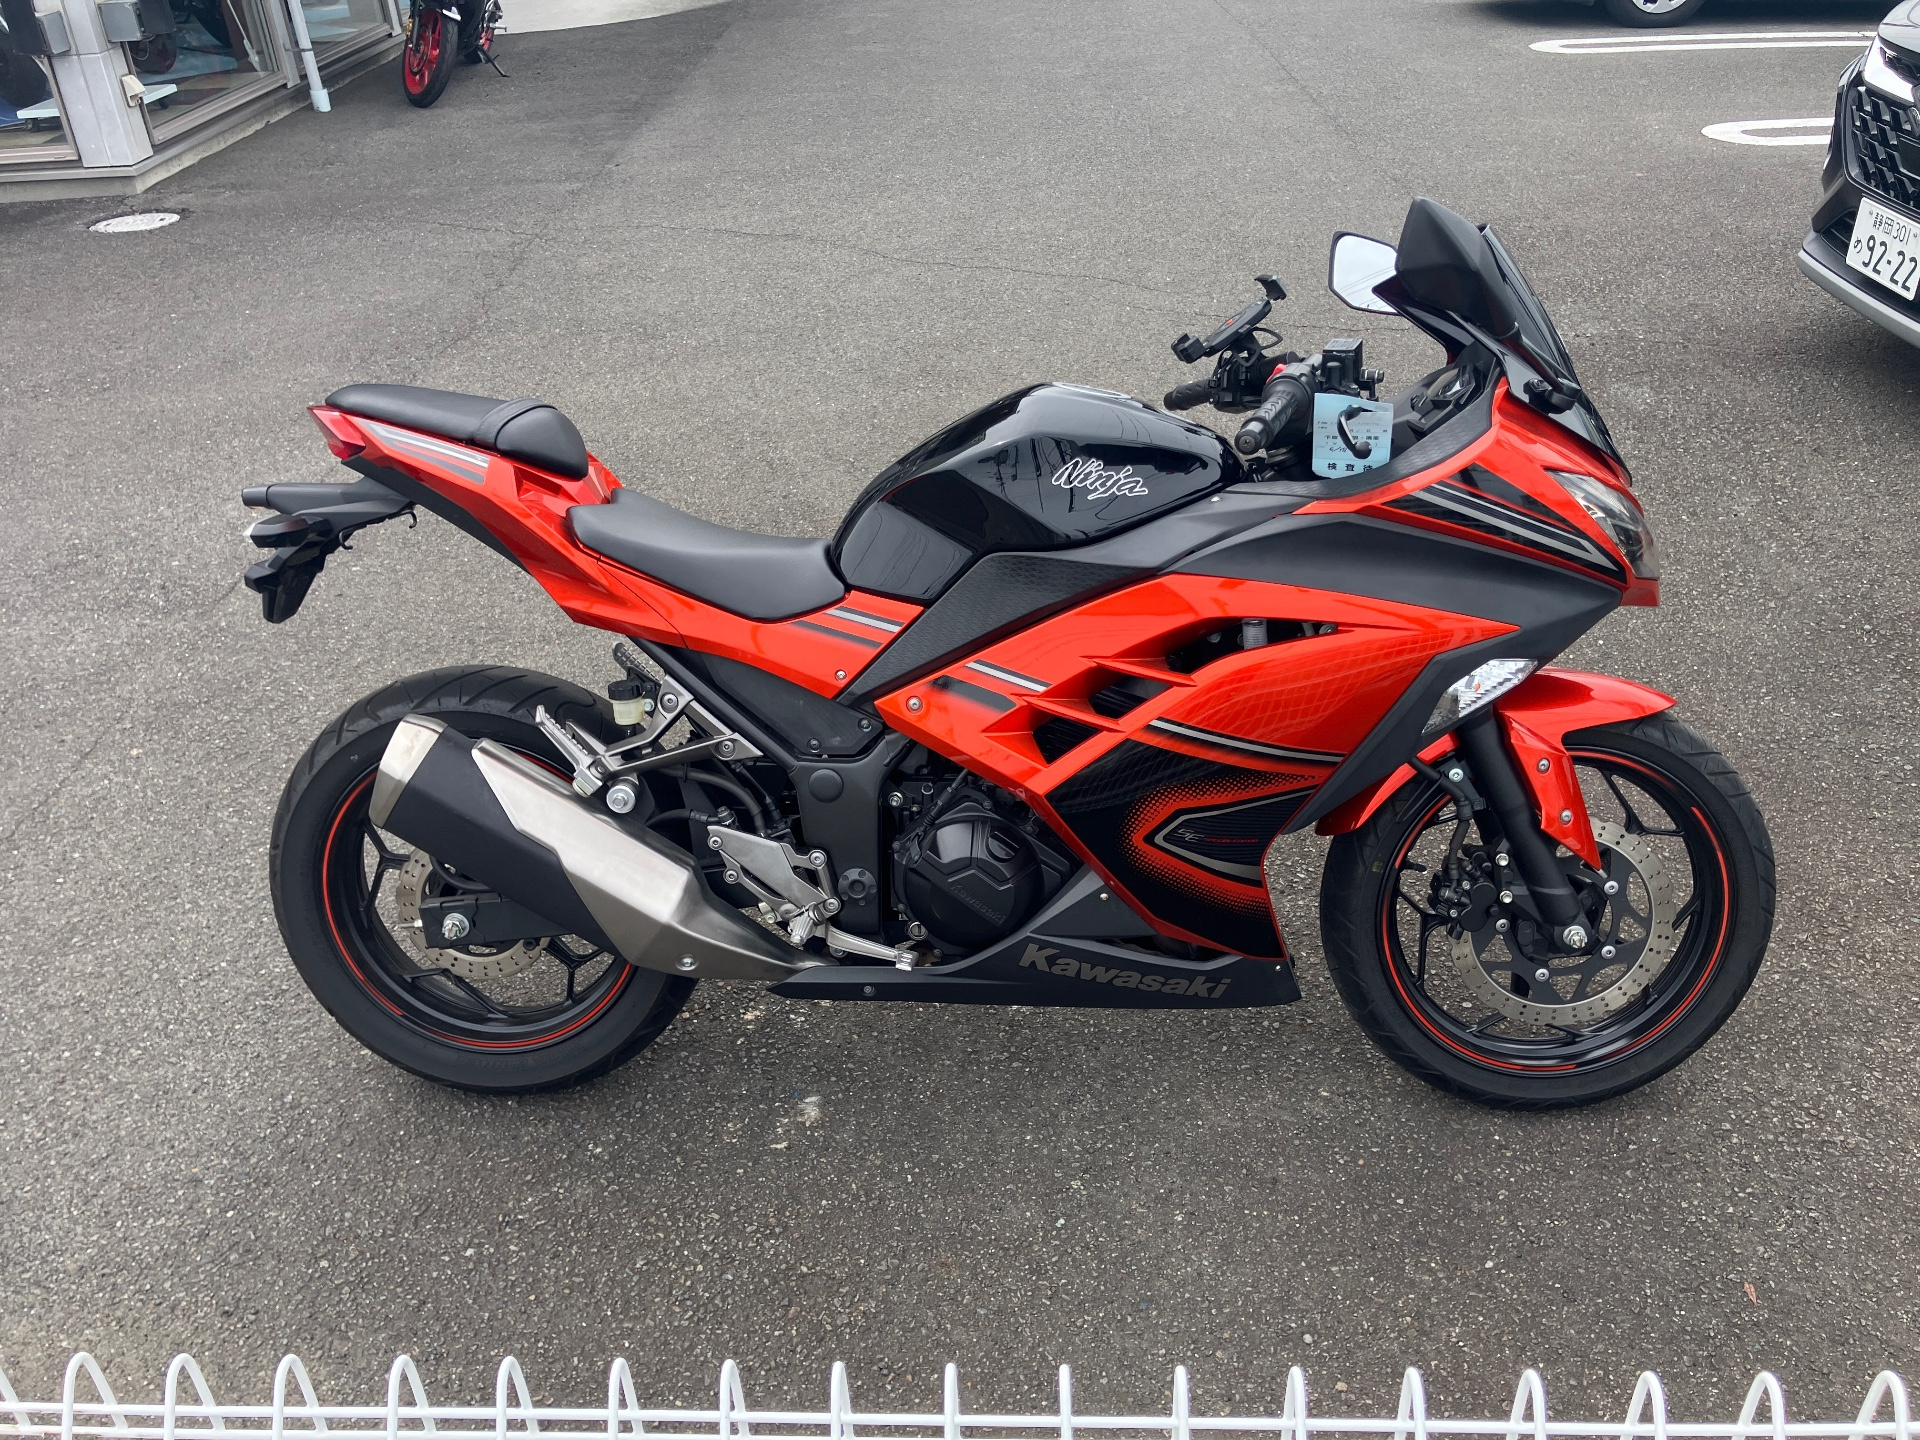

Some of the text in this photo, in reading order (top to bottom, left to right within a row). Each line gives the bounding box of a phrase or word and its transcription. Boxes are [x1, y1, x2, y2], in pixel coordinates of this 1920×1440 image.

[1872, 212, 1912, 245] 静岡 301
[1853, 234, 1918, 292] め 92-22
[1051, 458, 1149, 500] Ninja
[1173, 828, 1205, 843] SE
[1018, 942, 1232, 999] Kawasaki
